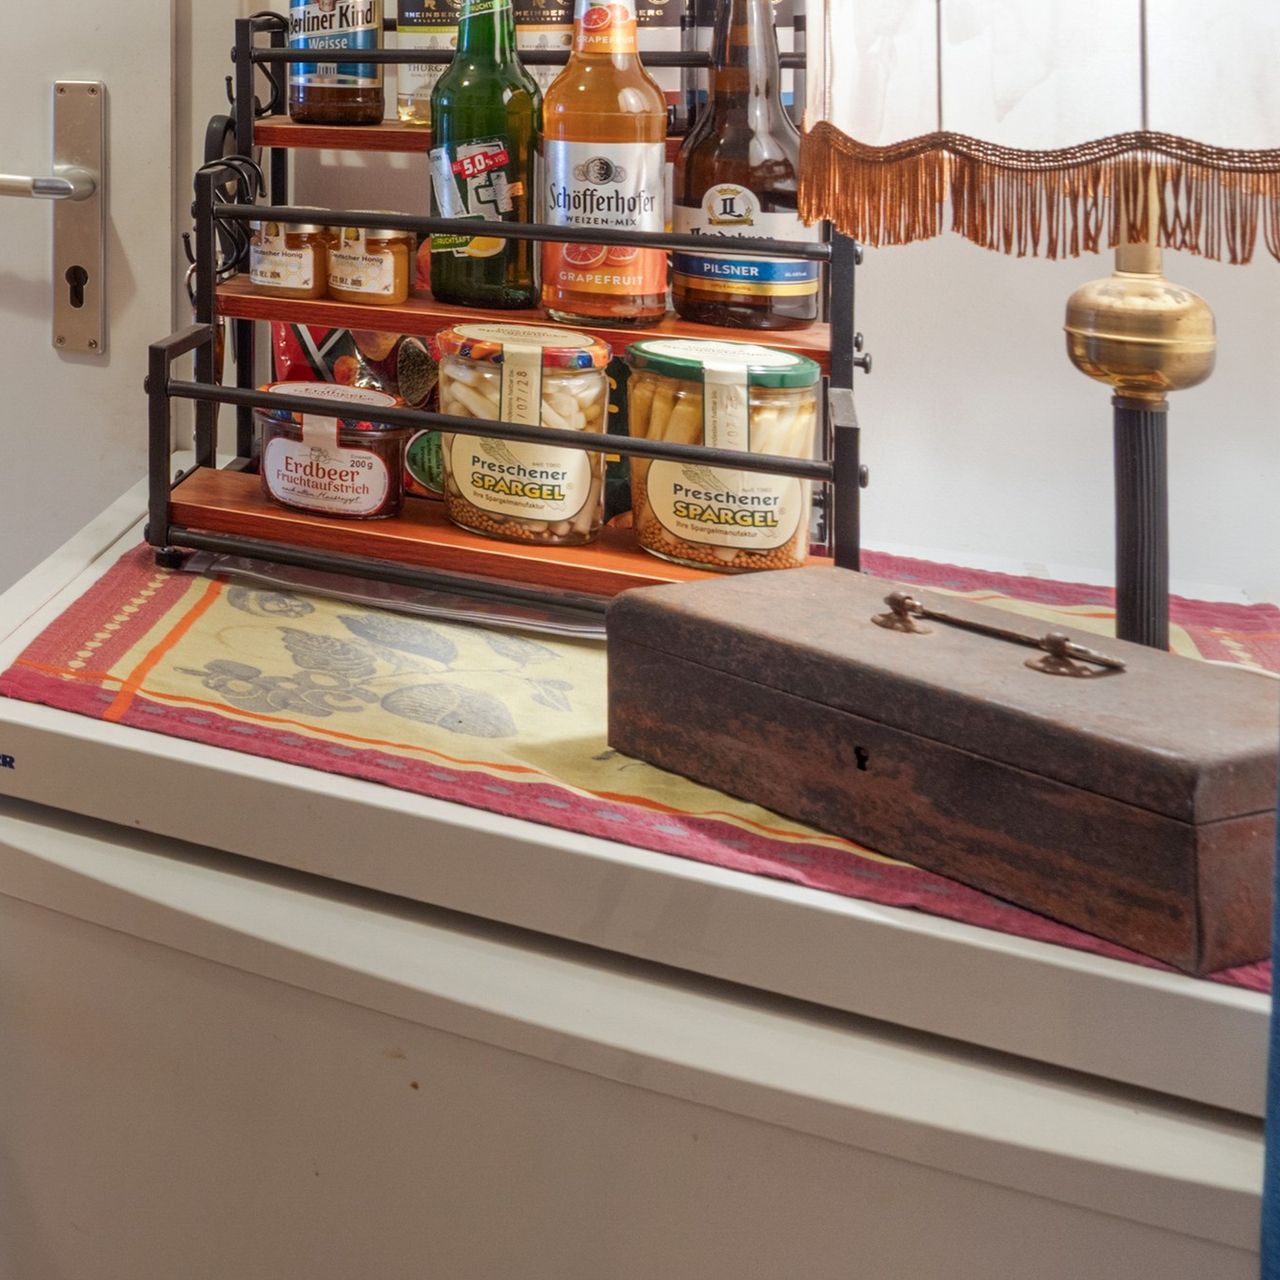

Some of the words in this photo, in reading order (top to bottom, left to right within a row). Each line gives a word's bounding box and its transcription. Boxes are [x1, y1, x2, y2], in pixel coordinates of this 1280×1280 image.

[290, 12, 336, 35] Berliner
[339, 1, 377, 28] Kindl
[308, 37, 349, 49] Weisse
[549, 182, 656, 215] Schöfferhofer
[564, 215, 638, 226] WEIZEN-MIX
[282, 251, 303, 259] Honig
[362, 256, 384, 264] Honig
[559, 271, 644, 286] GRAPEFRUIT
[703, 263, 759, 276] PILSNER
[285, 456, 360, 482] Erdbeer
[350, 460, 366, 468] 200
[471, 455, 568, 481] Preschener
[276, 469, 370, 495] Fruchtaufstrich
[471, 472, 566, 501] SPARGEL
[473, 491, 484, 500] Ihre
[485, 494, 545, 510] Spargelmanufaktur
[673, 483, 780, 507] Preschener
[673, 500, 779, 528] SPARGEL
[675, 521, 688, 529] Ihre
[690, 524, 758, 538] Spargelmanufaktur
